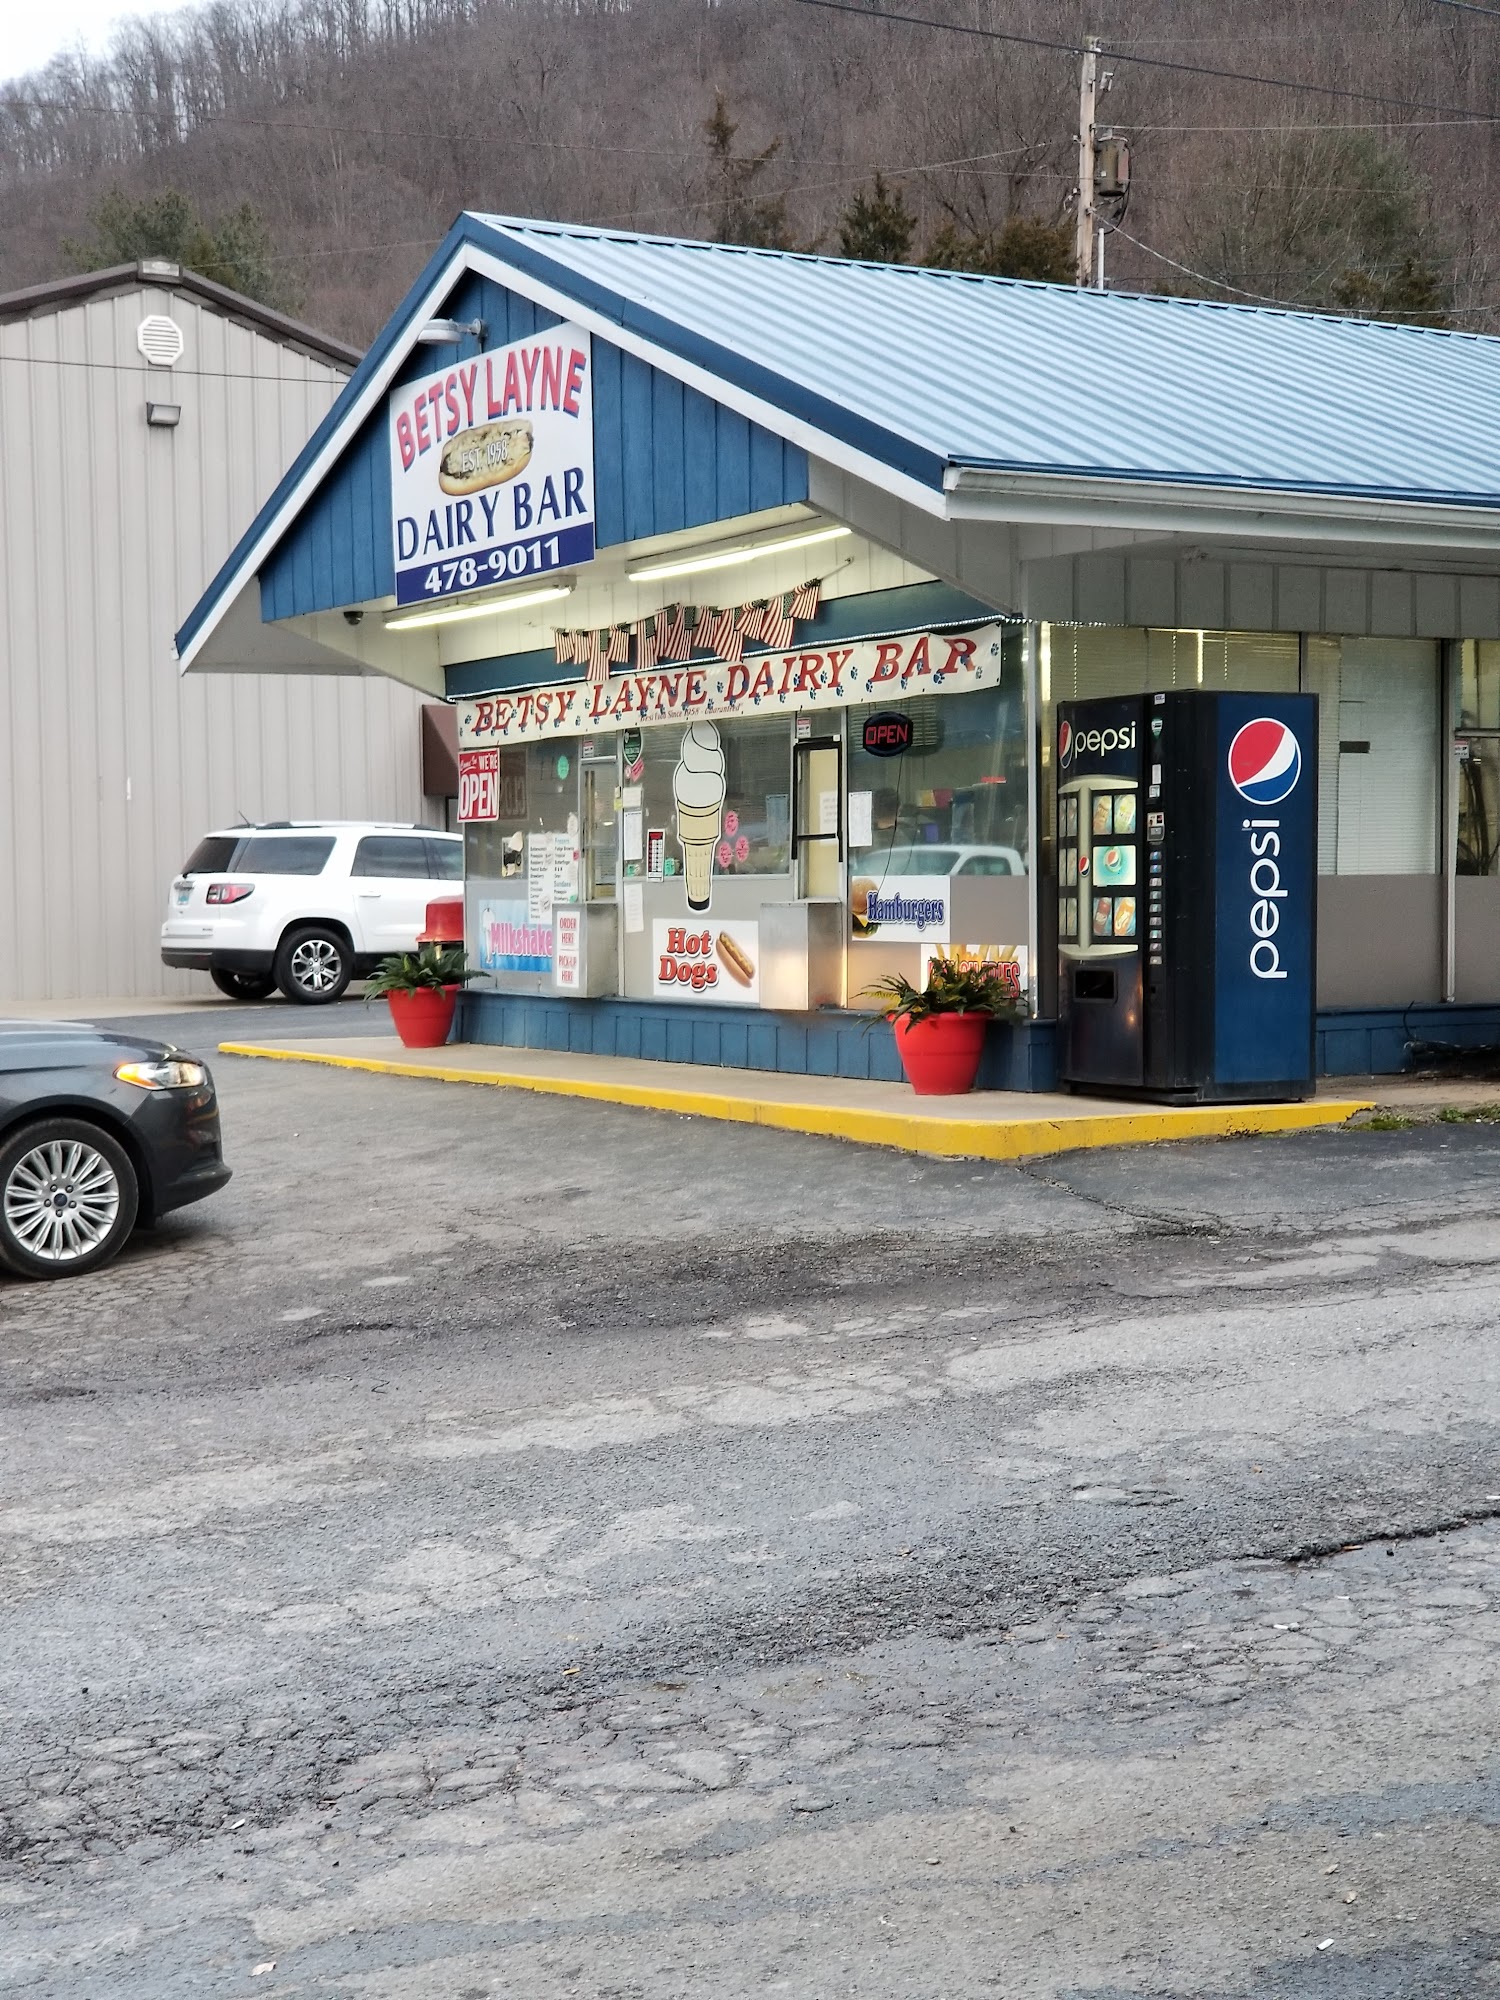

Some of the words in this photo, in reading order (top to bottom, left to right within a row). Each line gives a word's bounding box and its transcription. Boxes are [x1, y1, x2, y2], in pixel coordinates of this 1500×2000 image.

[396, 363, 477, 473] BETSY
[487, 346, 587, 419] LAYNE
[462, 447, 482, 472] EST.
[487, 440, 507, 466] 1958
[398, 491, 500, 561] DAIRY
[514, 467, 587, 530] BAR
[424, 536, 560, 593] 478-9011
[472, 690, 576, 733] BETSY
[589, 669, 708, 718] LAYNE
[724, 649, 854, 702] DAIRY
[870, 637, 978, 683] BAR
[865, 724, 908, 745] OPEN
[1074, 720, 1137, 759] pepsi
[479, 753, 497, 770] WE'RE
[460, 771, 498, 818] OPEN
[867, 891, 944, 930] Hamburgers
[1242, 819, 1288, 979] pepsi
[560, 918, 577, 930] ORDER
[562, 932, 574, 944] HERE
[666, 927, 712, 955] Hot
[658, 955, 718, 990] Dogs
